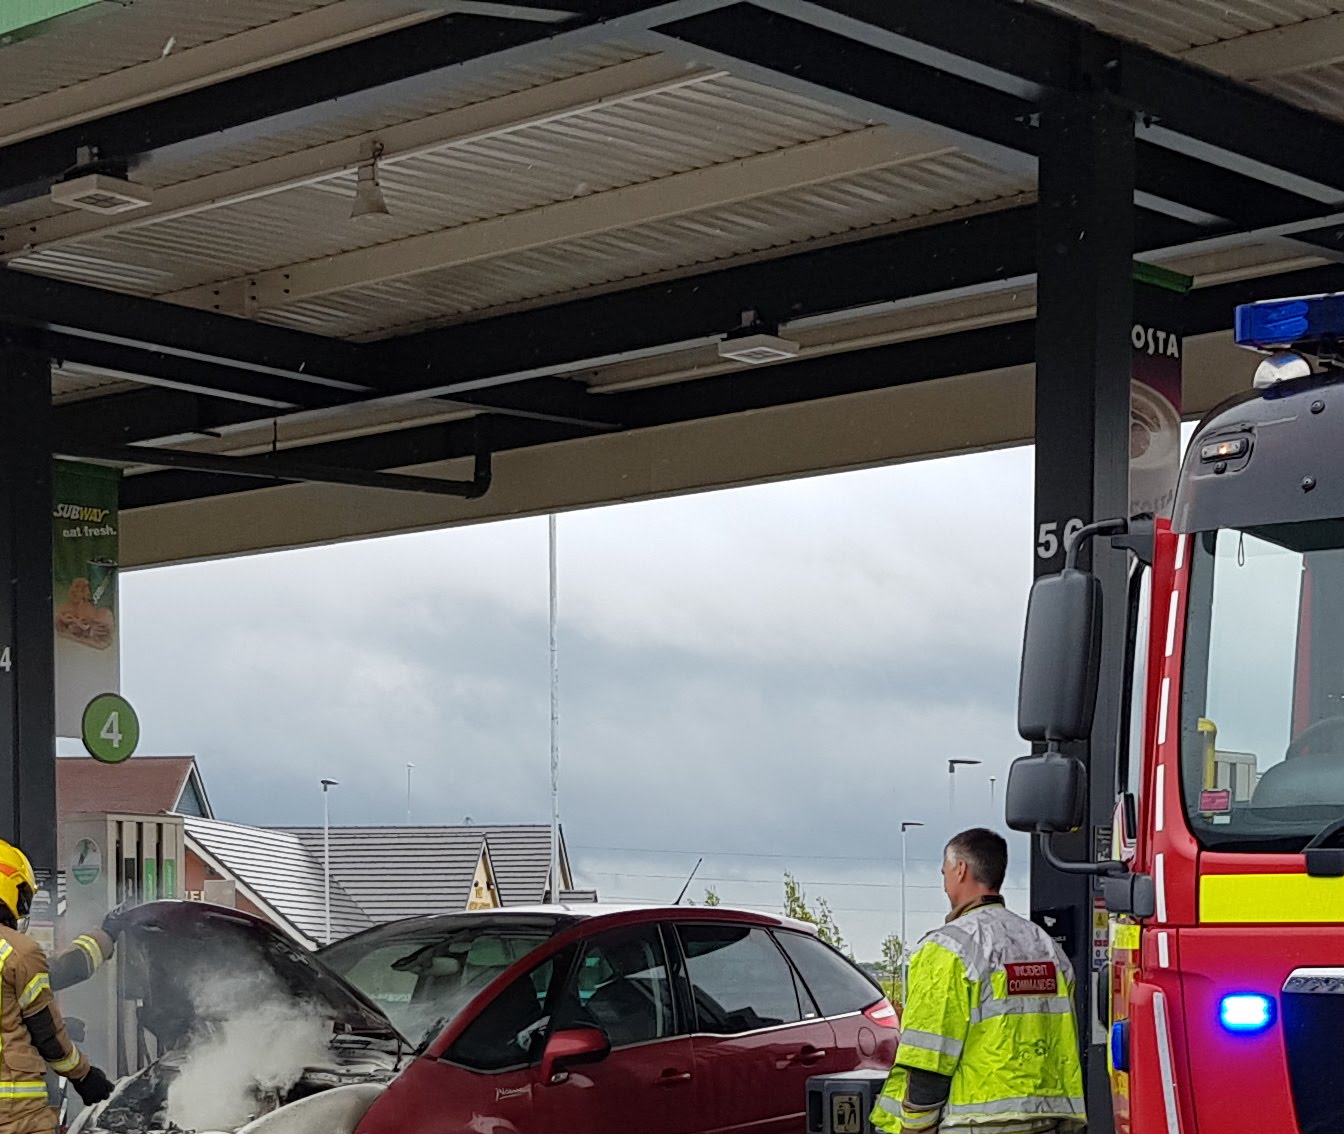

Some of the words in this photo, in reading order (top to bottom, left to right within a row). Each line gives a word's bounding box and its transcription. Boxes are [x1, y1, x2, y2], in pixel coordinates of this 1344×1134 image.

[1130, 324, 1179, 358] OSTA
[52, 503, 110, 523] SUBWAY
[62, 526, 82, 538] eat
[99, 711, 123, 748] 4
[1012, 964, 1048, 977] INCIDENT
[1009, 978, 1056, 992] COMMANDER
